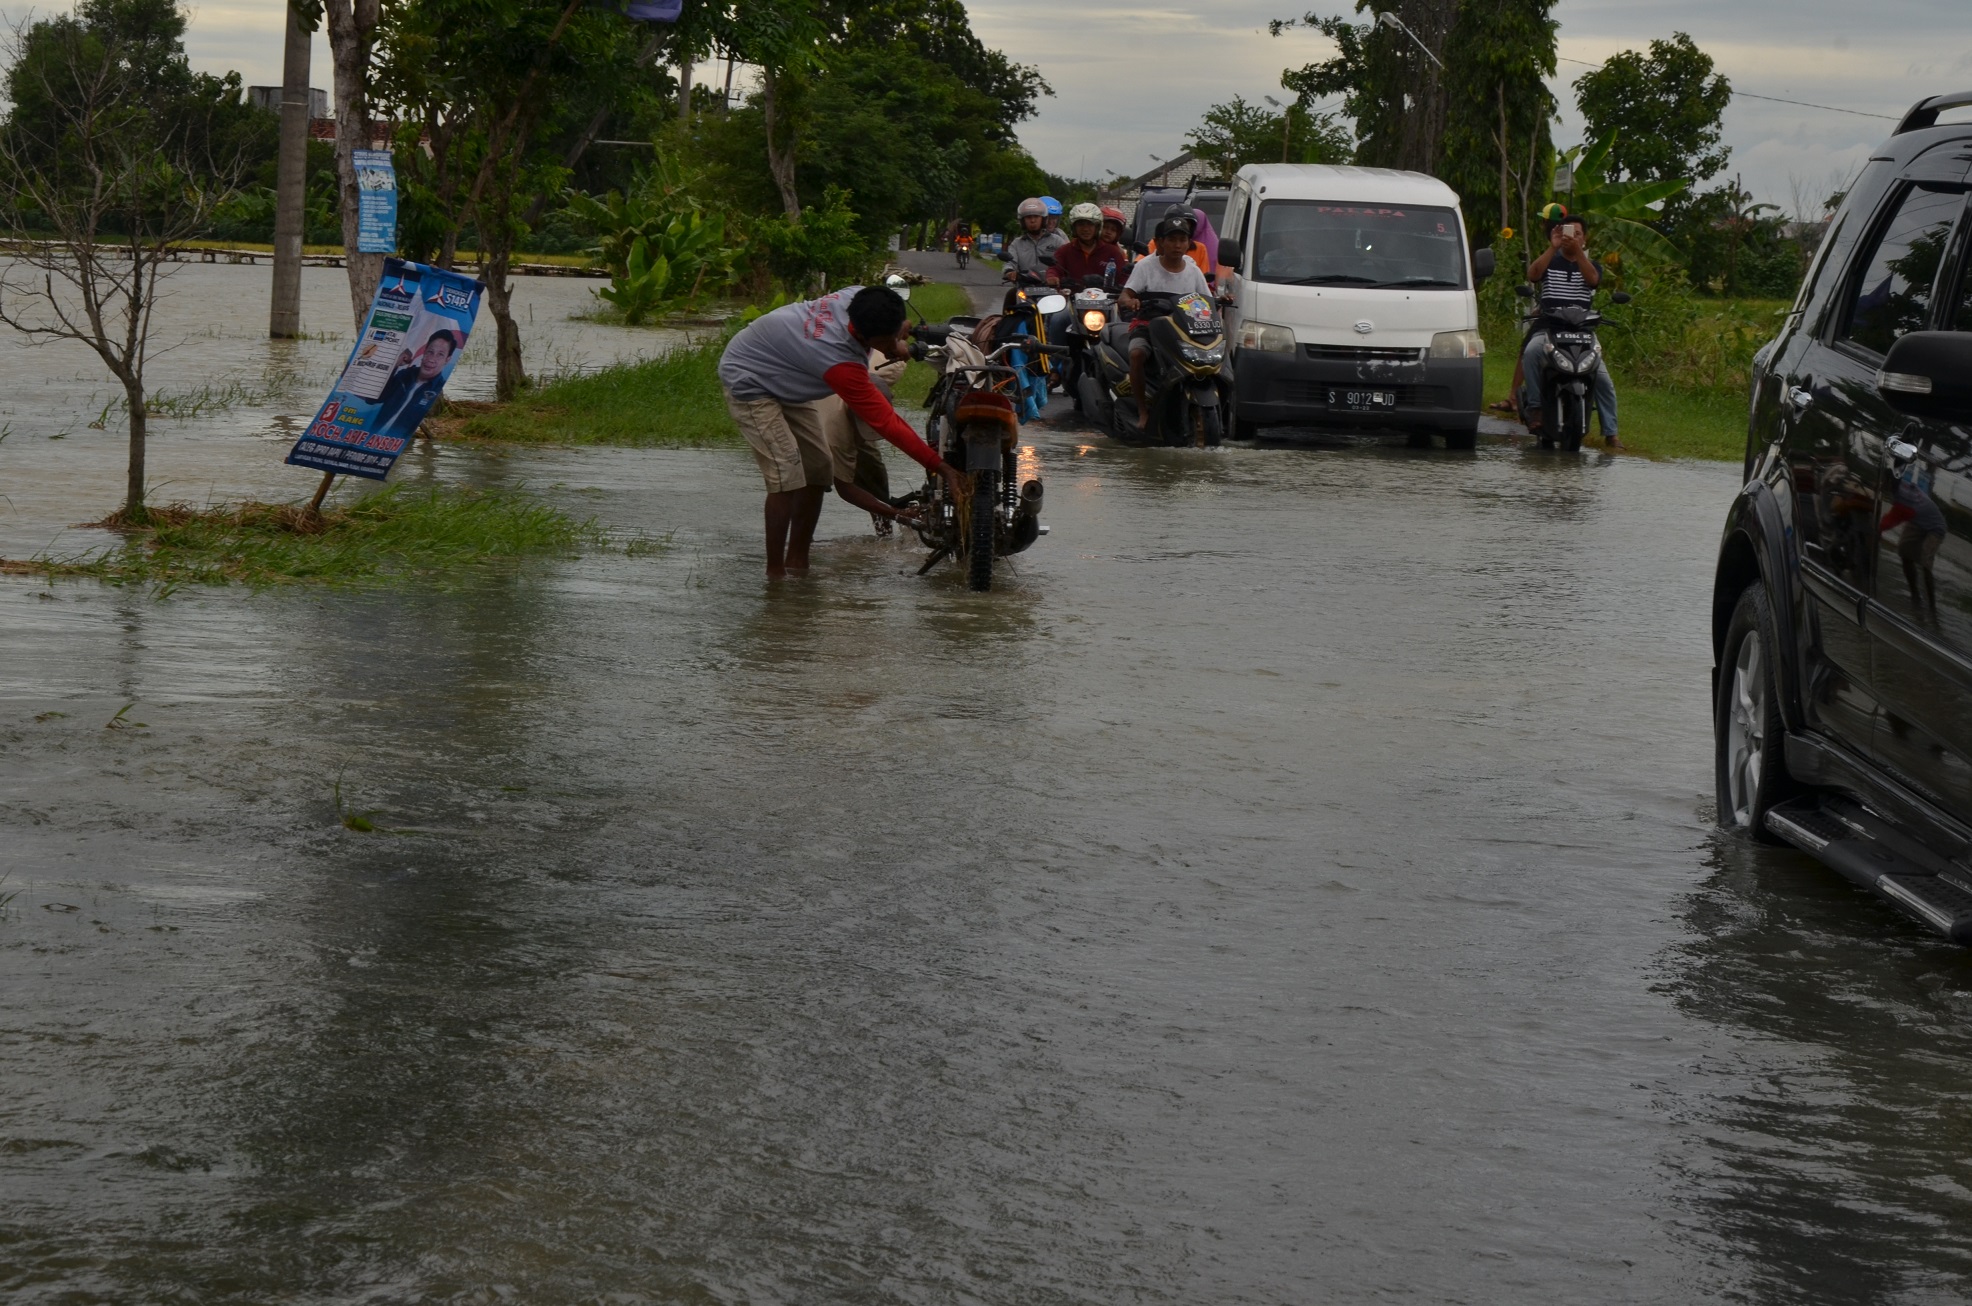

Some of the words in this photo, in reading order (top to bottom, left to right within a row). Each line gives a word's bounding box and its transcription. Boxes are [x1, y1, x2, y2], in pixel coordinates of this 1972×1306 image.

[1188, 322, 1193, 330] L
[1194, 321, 1211, 329] 6330
[1328, 391, 1336, 404] S
[1346, 391, 1373, 405] 9012
